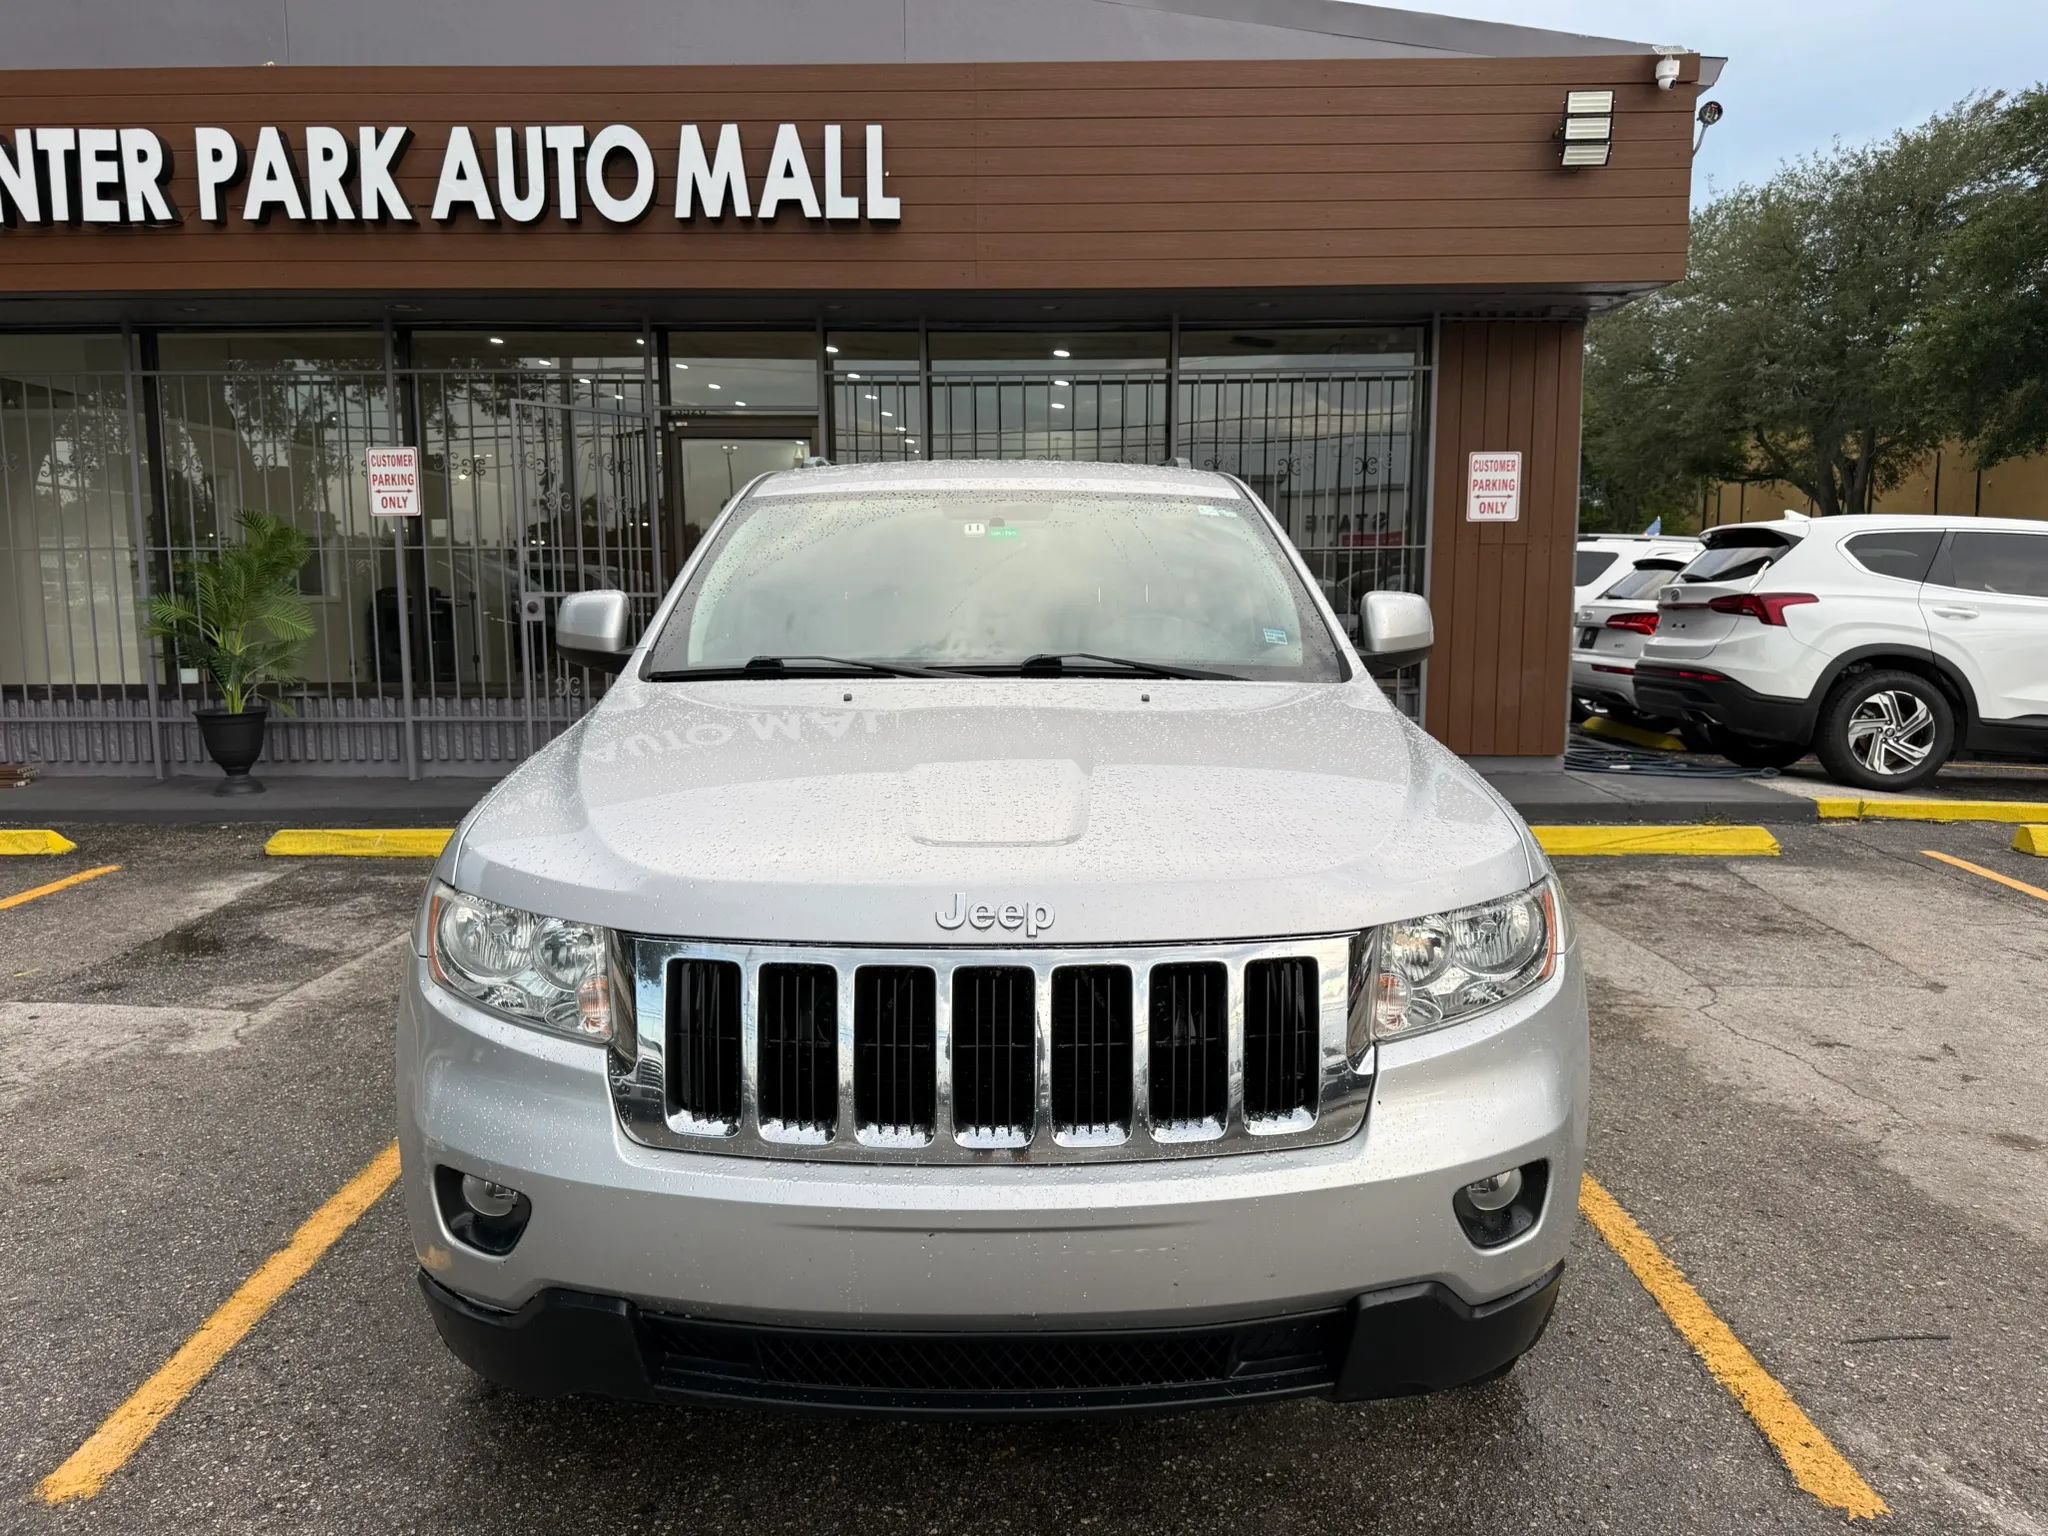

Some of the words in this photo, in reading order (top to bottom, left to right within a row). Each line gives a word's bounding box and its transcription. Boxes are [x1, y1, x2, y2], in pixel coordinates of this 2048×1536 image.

[195, 126, 412, 220] PARK
[431, 124, 655, 222] AUTO
[675, 123, 901, 220] MALL
[371, 454, 413, 467] CUSTOMER
[1473, 459, 1516, 472] CUSTOMER
[372, 473, 414, 486] PARKING
[1472, 478, 1515, 492] PARKING
[381, 496, 408, 508] ONLY
[1479, 501, 1507, 514] ONLY
[935, 892, 1055, 938] Jeep
